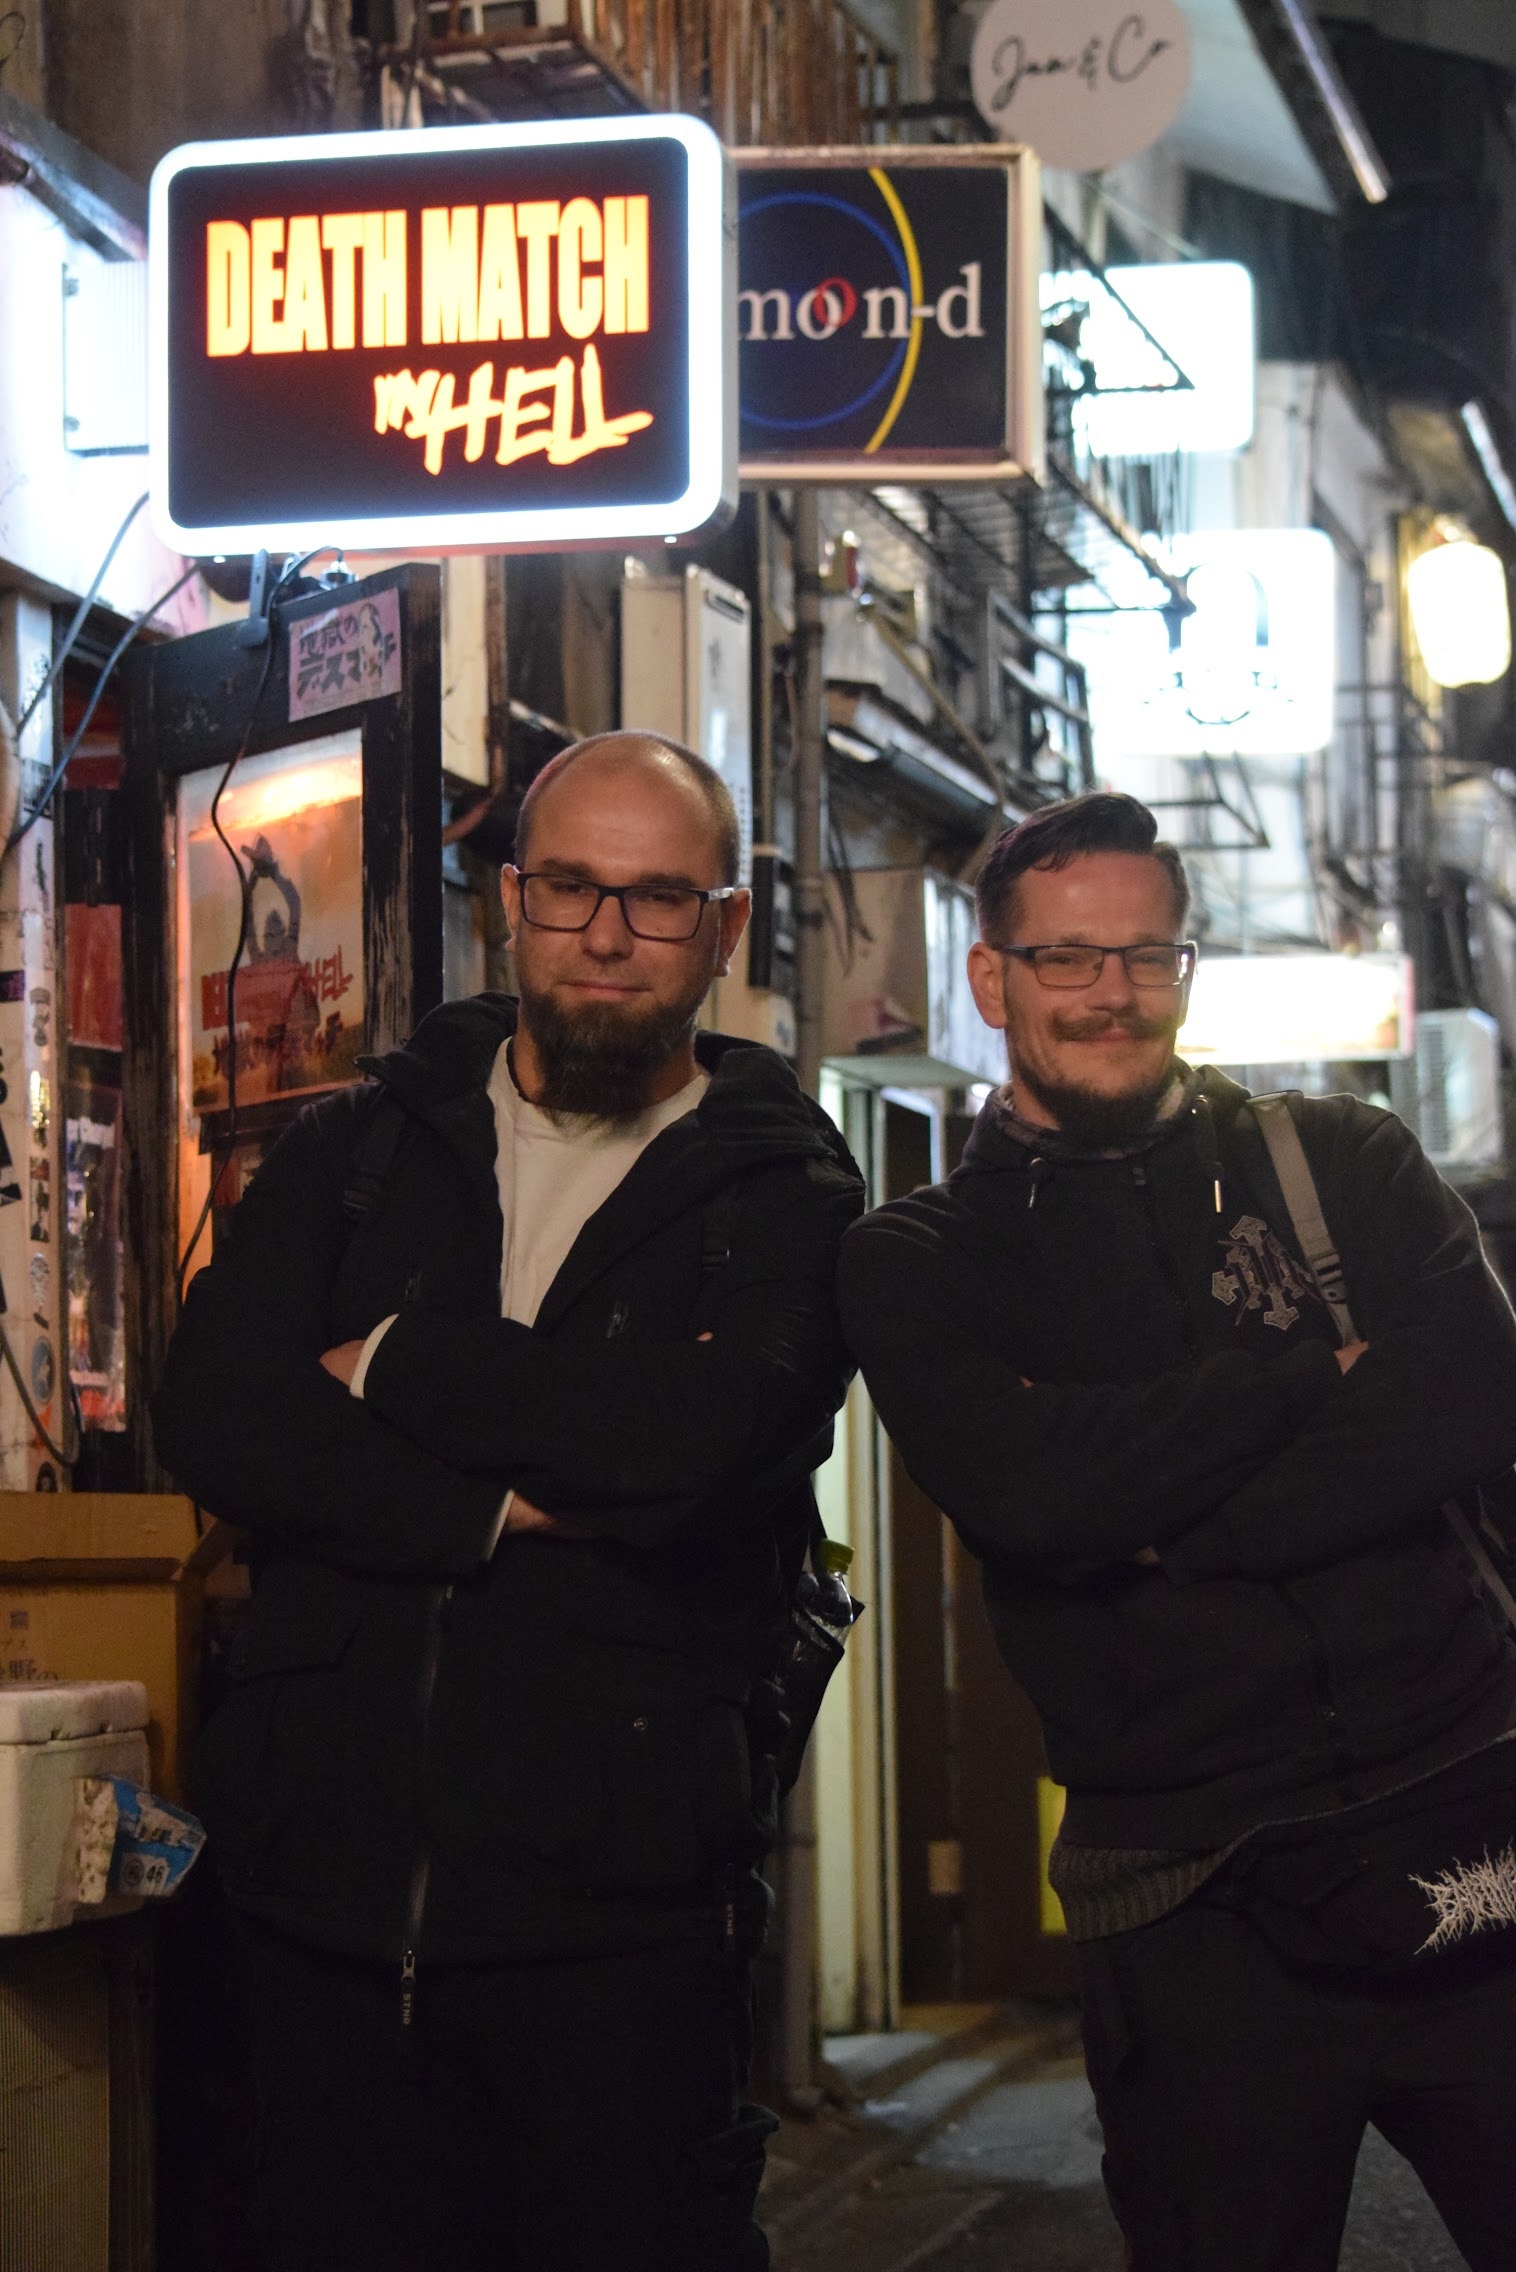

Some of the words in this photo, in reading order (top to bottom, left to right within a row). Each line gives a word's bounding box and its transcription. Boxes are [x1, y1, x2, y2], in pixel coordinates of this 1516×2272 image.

[1107, 14, 1170, 83] Co
[206, 209, 408, 358] DEATH
[421, 194, 650, 346] MATCH
[424, 343, 655, 476] HELL
